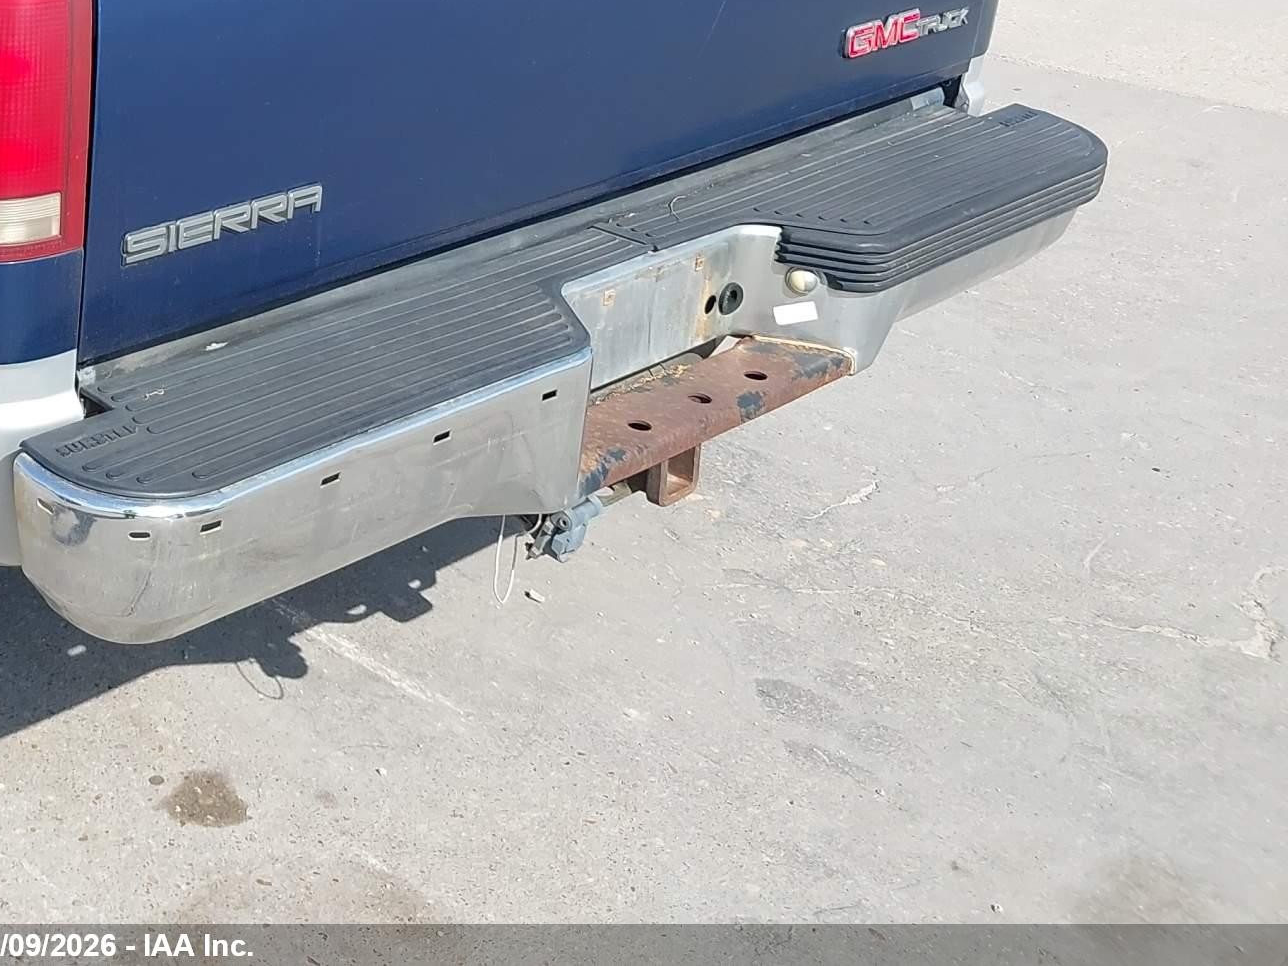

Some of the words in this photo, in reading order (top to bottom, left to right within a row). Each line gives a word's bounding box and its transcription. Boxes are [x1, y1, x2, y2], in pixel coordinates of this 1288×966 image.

[843, 8, 920, 58] GMC
[916, 6, 969, 37] TRUCK
[123, 183, 323, 265] SIERRA
